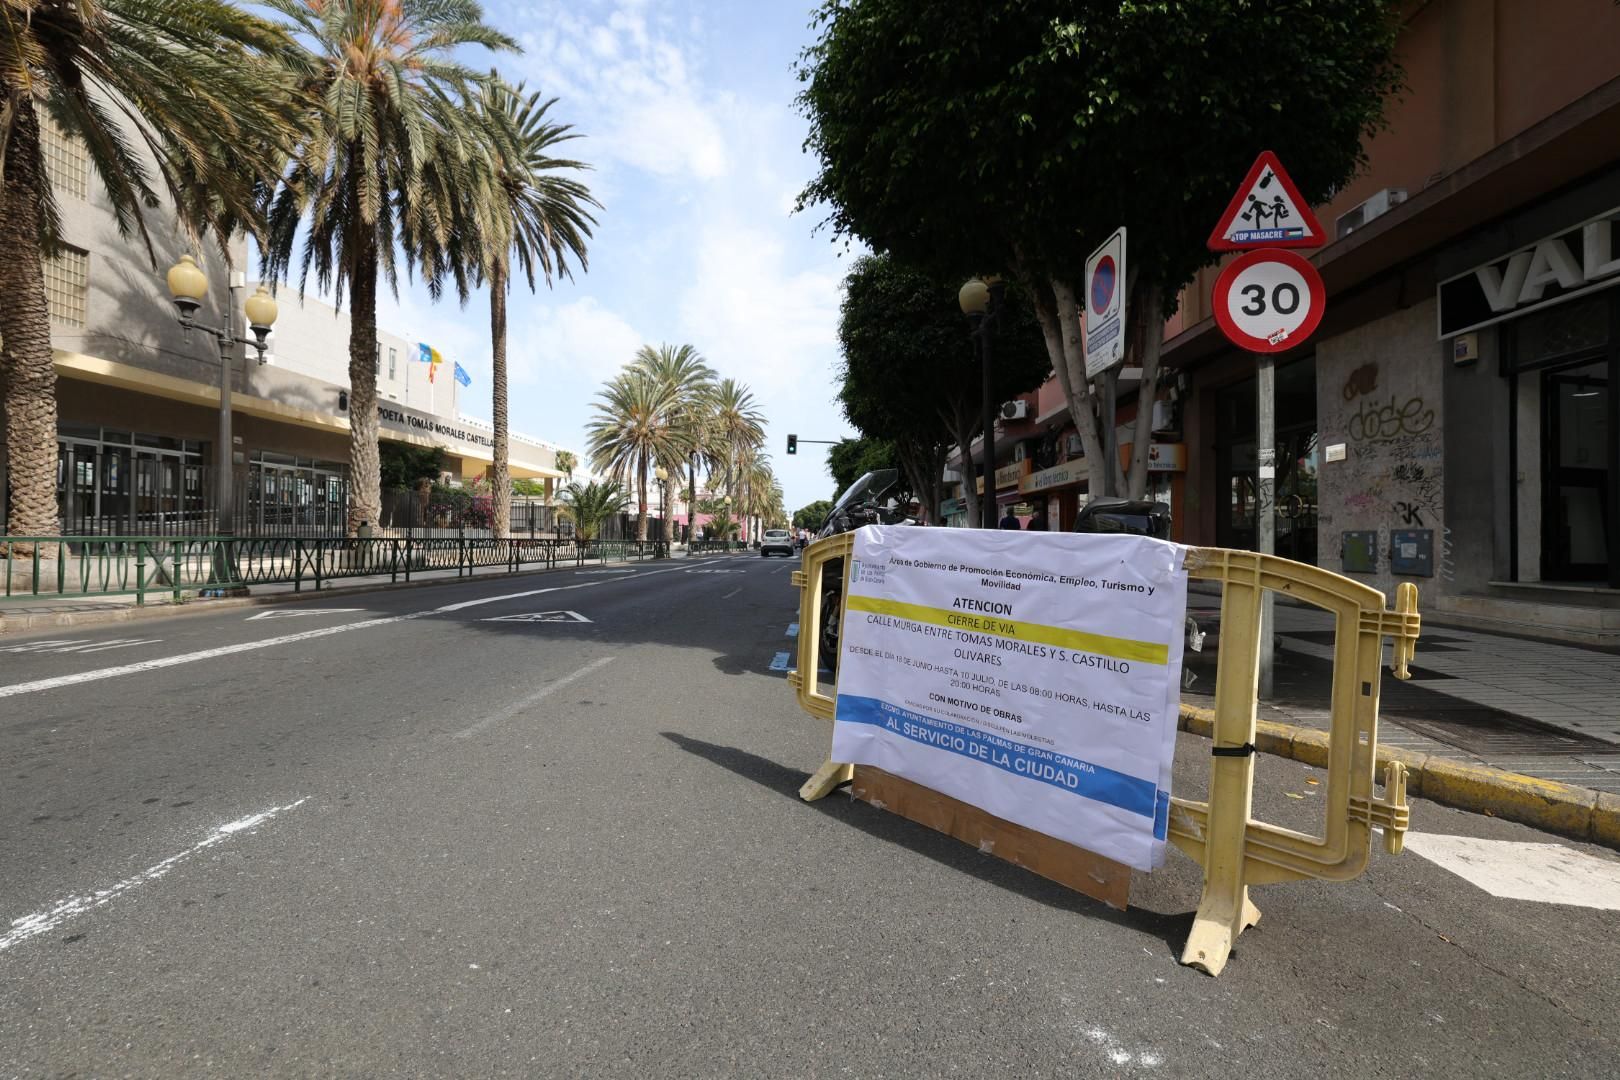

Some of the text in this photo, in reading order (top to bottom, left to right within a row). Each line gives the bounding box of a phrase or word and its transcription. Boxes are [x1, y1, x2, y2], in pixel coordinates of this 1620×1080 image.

[1250, 230, 1283, 240] MASACRE
[1240, 282, 1300, 317] 30
[378, 407, 404, 425] POETA
[407, 415, 434, 432] TOMÁS
[435, 424, 465, 440] MORALES
[904, 559, 913, 567] de
[913, 560, 946, 571] Gobierno
[948, 563, 958, 572] de
[960, 565, 1003, 577] Promoción
[1059, 575, 1098, 589] Empleo,
[1101, 579, 1145, 593] Turismo
[1148, 586, 1156, 596] y
[981, 578, 1021, 591] Movilidad
[953, 597, 1012, 616] ATENCION
[947, 614, 980, 628] CIERRE
[983, 619, 997, 632] DE
[866, 614, 1130, 674] CALLE MURGA ENTRE TOMAS MORALES Y S. CASTILLO
[954, 648, 1002, 667] OLIVARES
[849, 645, 873, 656] DESDE
[874, 649, 884, 658] EL
[903, 656, 911, 666] DE
[912, 659, 933, 672] JUNIO
[934, 665, 958, 678] HASTA
[960, 670, 970, 680] 10
[998, 679, 1009, 689] DE
[1010, 682, 1028, 693] LAS
[1029, 686, 1053, 699] 08:00
[1093, 701, 1127, 717] HASTA
[1129, 709, 1151, 723] LAS
[950, 679, 1001, 698] 20:00 HORAS
[929, 692, 1022, 724] CON MOTIVO DE OBRAS
[886, 716, 1079, 789] AL SERVICIO DE LA CIUDAD
[902, 710, 954, 731] AYUNTAMIENTO
[954, 725, 965, 735] DE
[966, 728, 981, 740] LAS
[982, 732, 1012, 750] PALMAS
[1014, 744, 1026, 754] DE
[1027, 746, 1053, 761] GRAN
[1054, 755, 1096, 775] CANARIA
